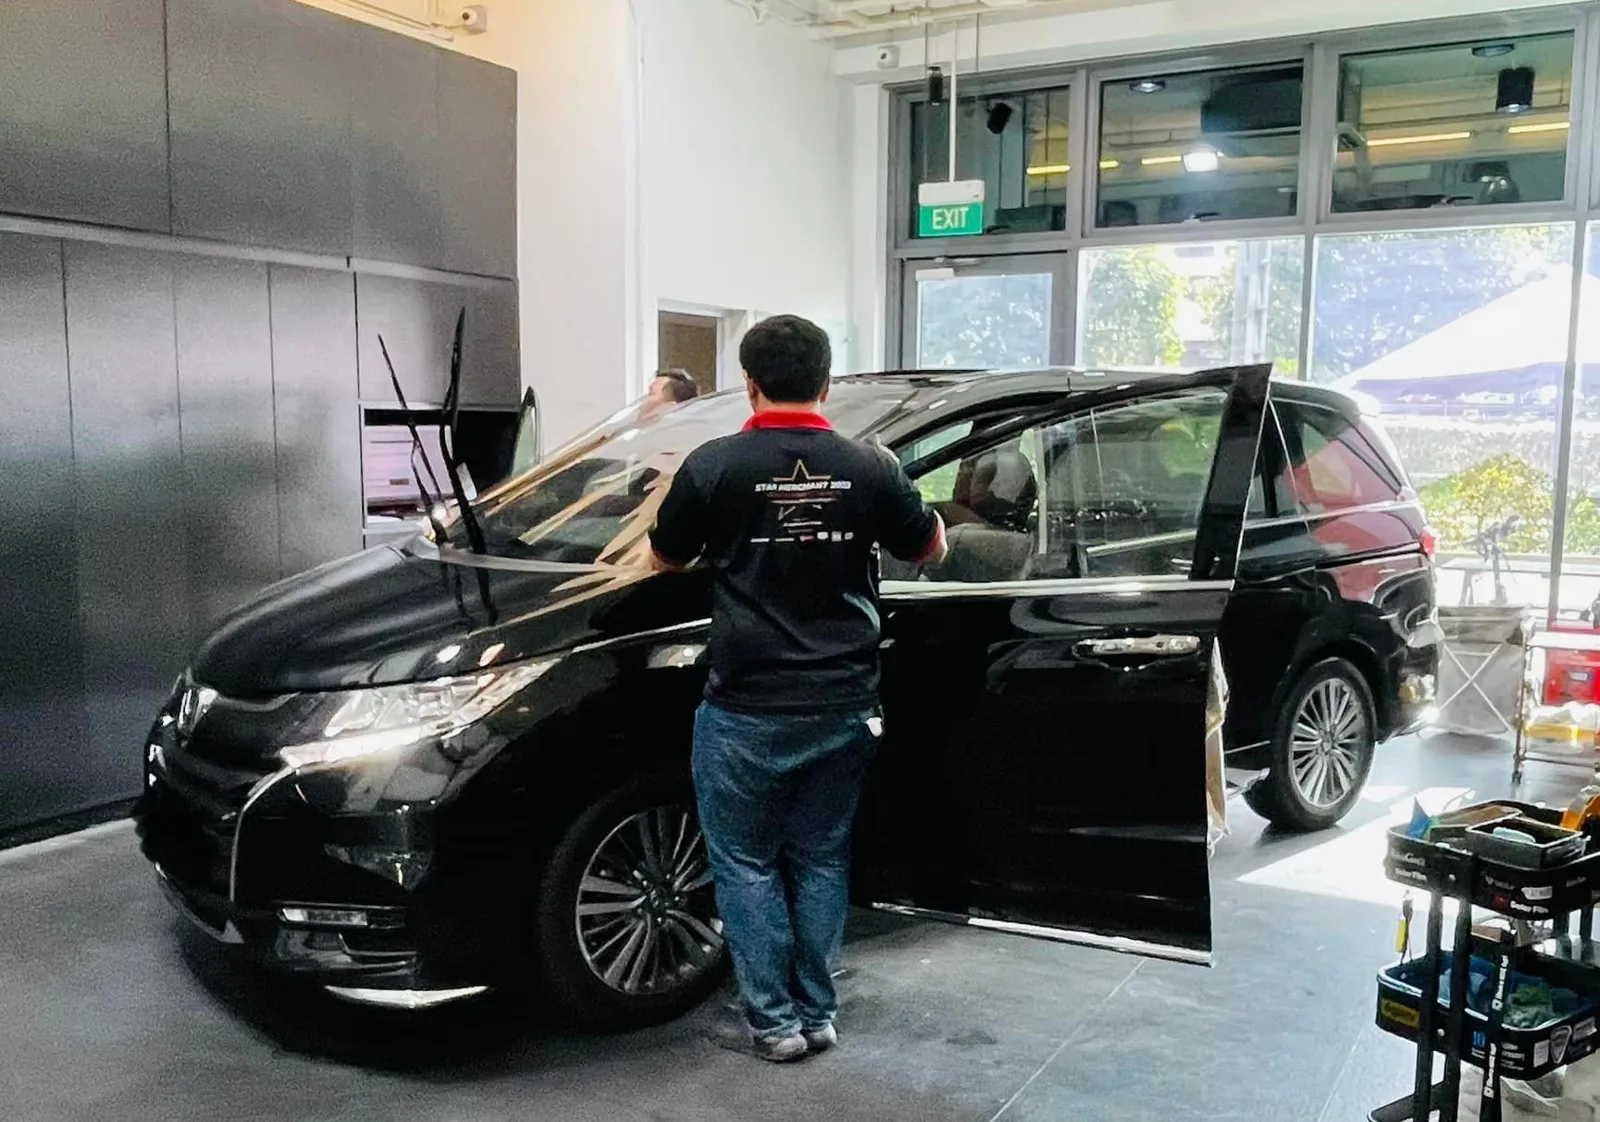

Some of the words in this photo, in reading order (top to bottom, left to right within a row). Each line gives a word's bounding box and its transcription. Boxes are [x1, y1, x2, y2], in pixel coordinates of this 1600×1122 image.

[932, 206, 969, 230] EXIT
[755, 483, 777, 492] STAR
[778, 481, 829, 491] MERCHANT
